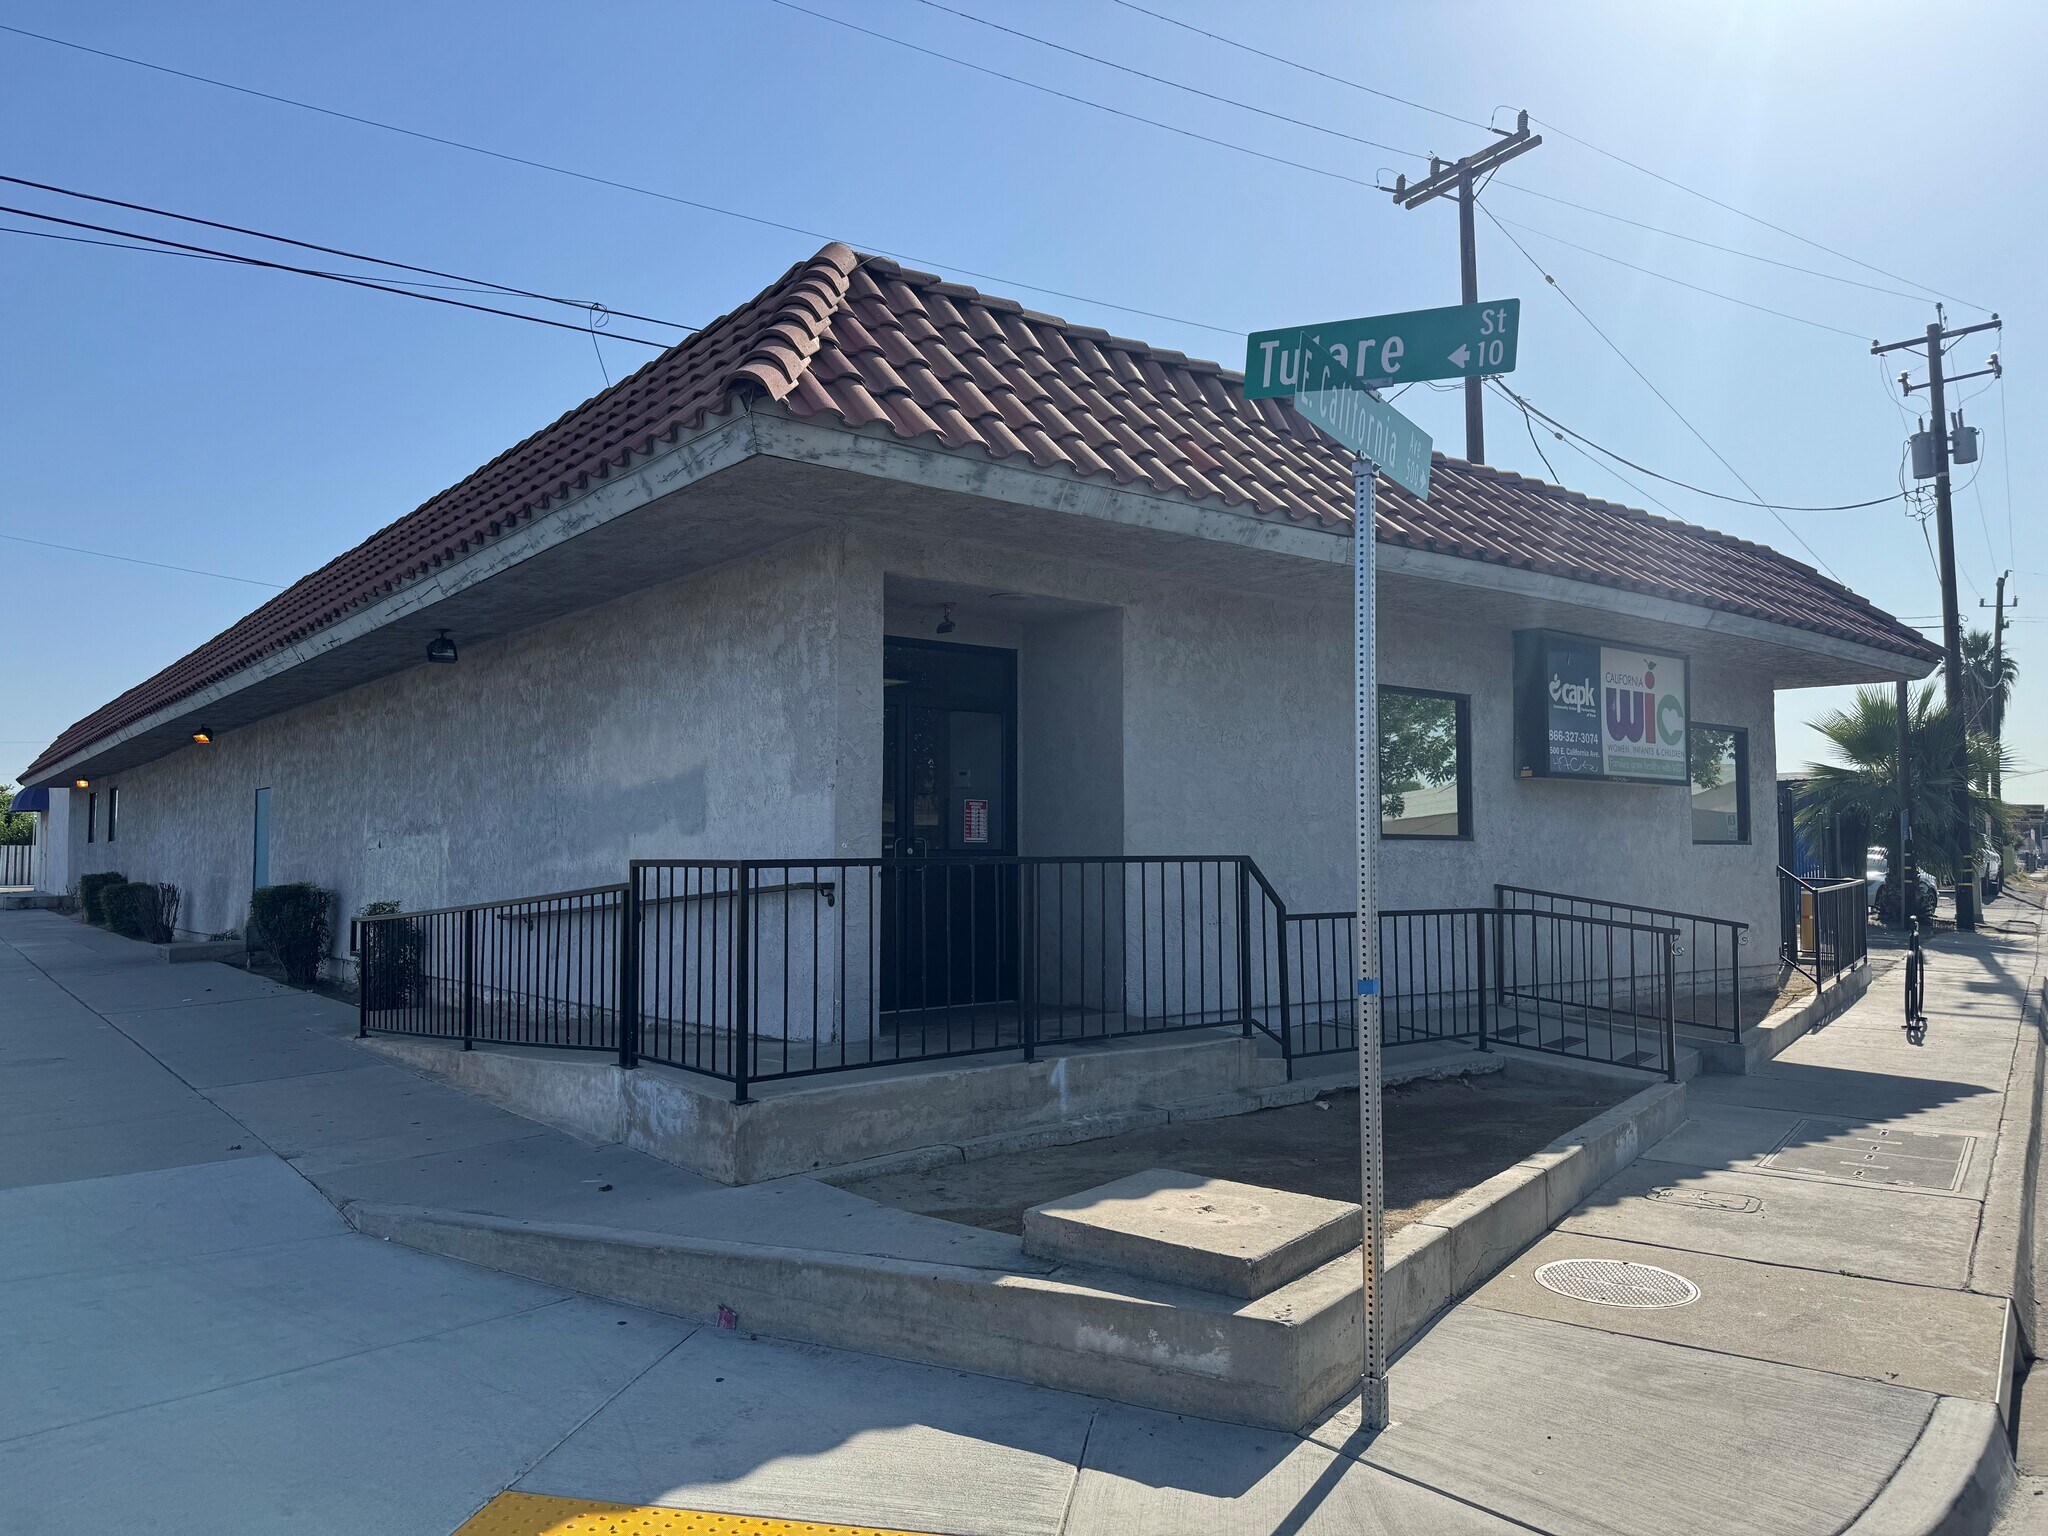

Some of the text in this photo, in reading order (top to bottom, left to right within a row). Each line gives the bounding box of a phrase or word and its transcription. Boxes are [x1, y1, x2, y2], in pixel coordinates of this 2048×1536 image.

[1480, 308, 1507, 335] St
[1259, 334, 1405, 388] Tuare
[1477, 339, 1504, 368] 10
[1301, 349, 1397, 469] E. California
[1408, 430, 1422, 459] Ave
[1405, 457, 1420, 487] 500
[1605, 671, 1644, 687] CALIFORNIA
[1561, 677, 1596, 714] capk
[1549, 729, 1599, 745] 866-327-3074
[1633, 746, 1655, 756] INFANTS
[1660, 748, 1685, 758] CHILDREN
